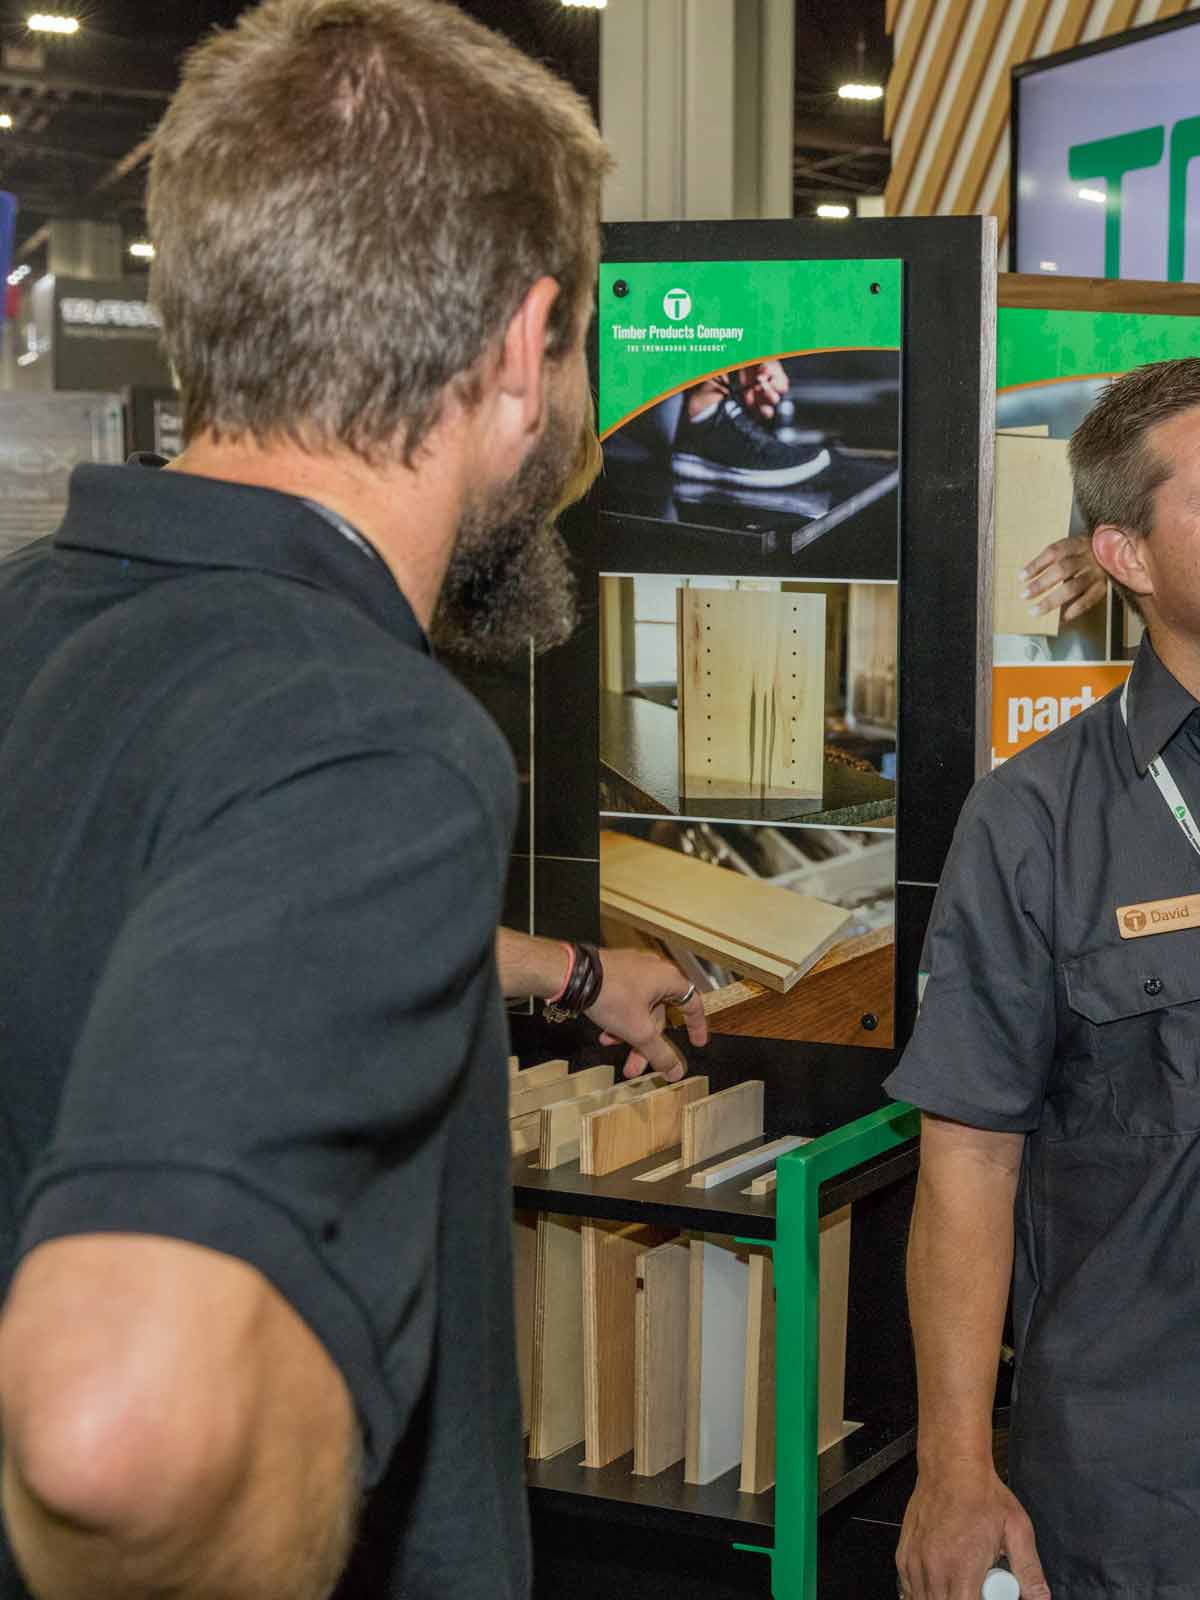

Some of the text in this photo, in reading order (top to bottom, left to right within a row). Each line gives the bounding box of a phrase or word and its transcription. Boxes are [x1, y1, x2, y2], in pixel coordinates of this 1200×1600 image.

[612, 323, 743, 341] Timber Products Company
[1008, 686, 1104, 743] part
[1150, 904, 1190, 923] David
